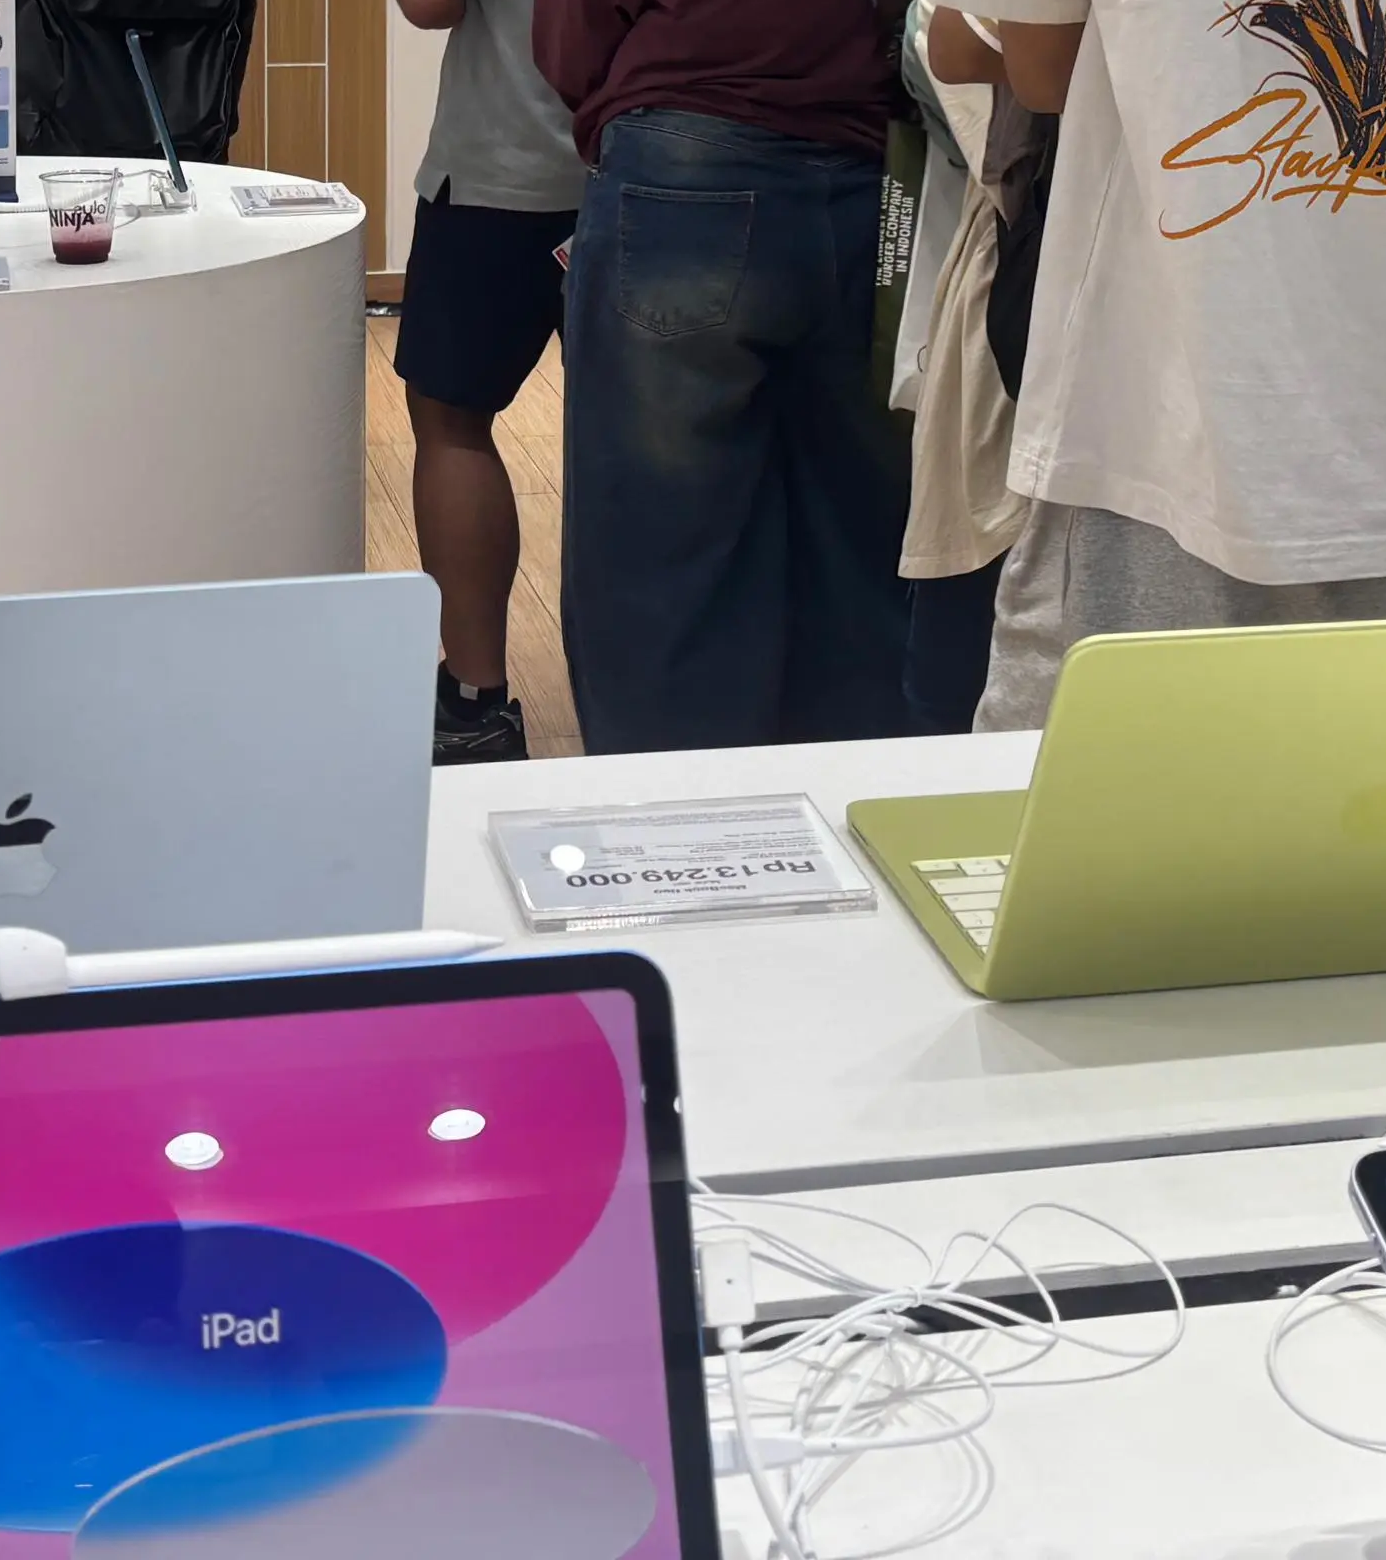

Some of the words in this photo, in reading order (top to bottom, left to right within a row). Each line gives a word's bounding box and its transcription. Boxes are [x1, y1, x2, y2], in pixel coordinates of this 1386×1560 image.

[48, 207, 96, 233] NINJA
[885, 179, 905, 239] COMPANY
[896, 196, 915, 257] INDONESIA
[895, 259, 908, 273] IN
[199, 1308, 282, 1352] iPad
